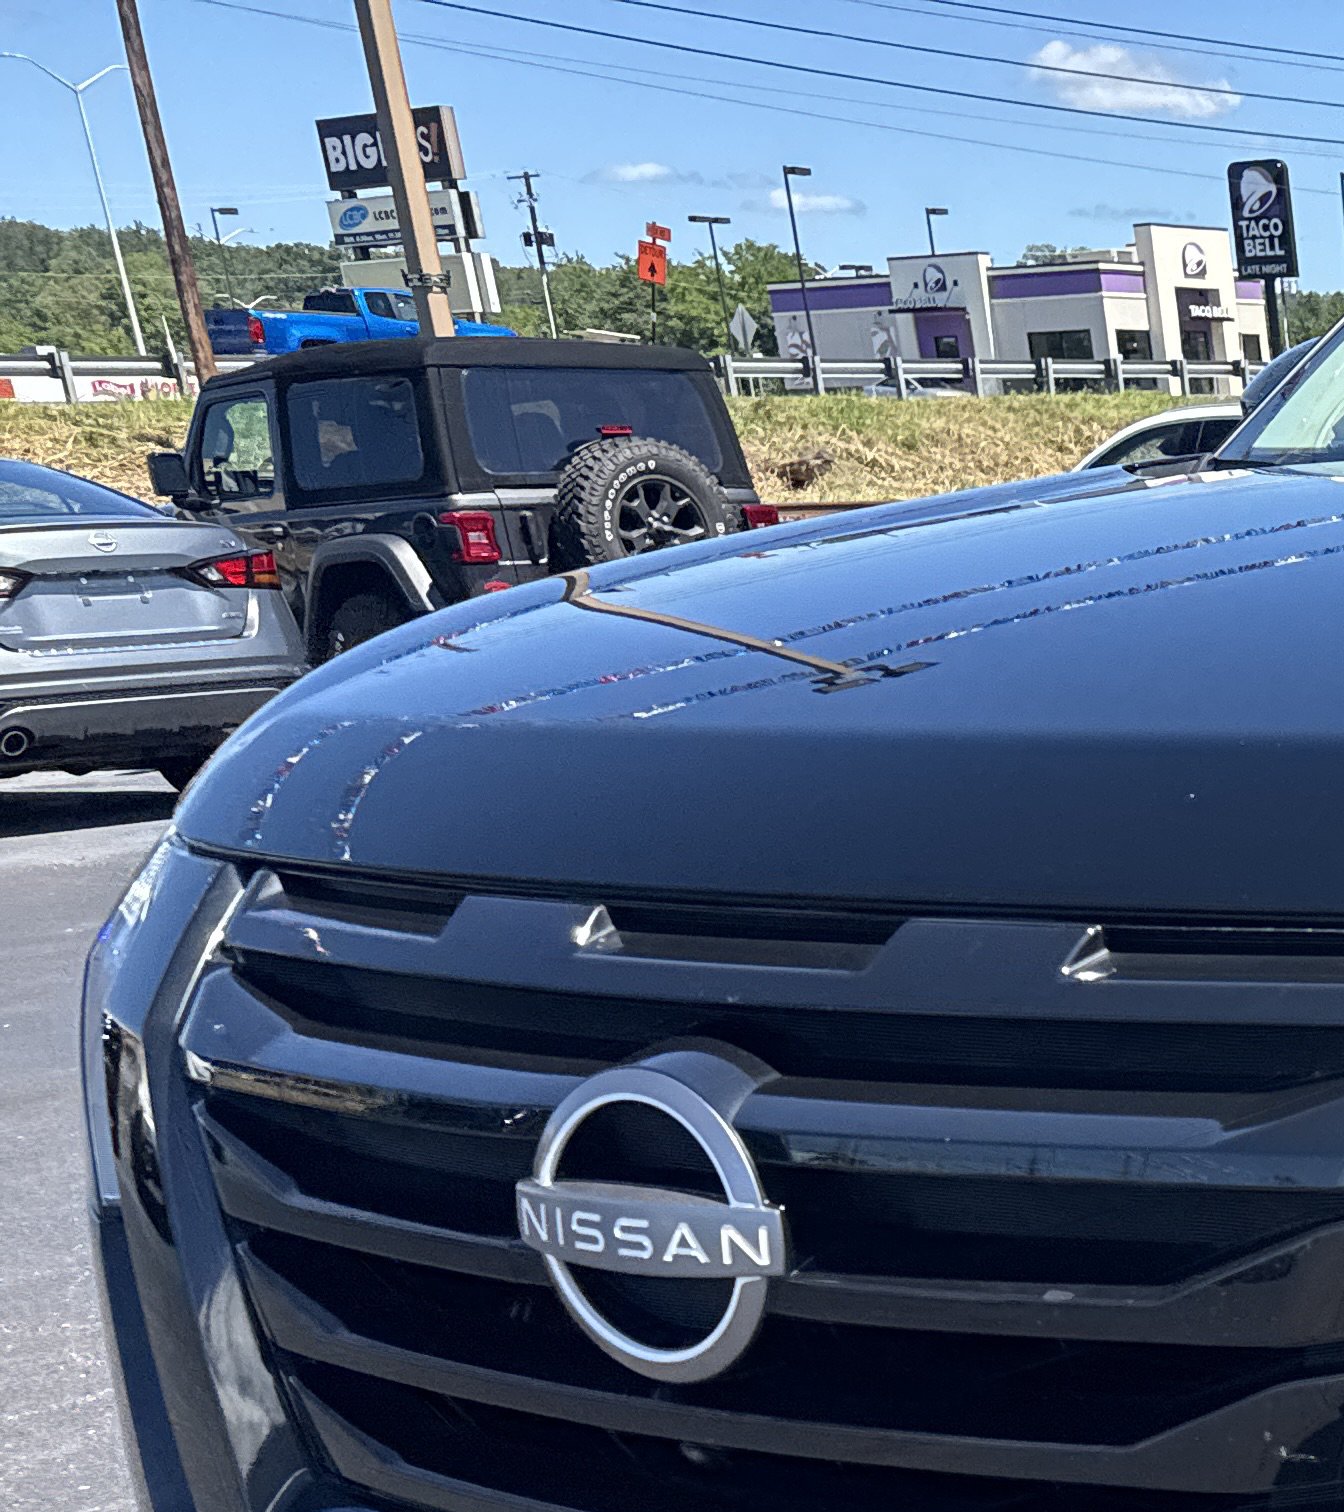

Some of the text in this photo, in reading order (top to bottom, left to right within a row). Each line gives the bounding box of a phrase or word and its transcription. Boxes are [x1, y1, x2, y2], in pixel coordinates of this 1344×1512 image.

[1237, 217, 1284, 239] TACO
[639, 244, 665, 259] DETOUR
[1243, 237, 1286, 258] BELL
[1241, 262, 1288, 276] LATE NIGHT
[1188, 304, 1212, 318] TACO
[518, 1196, 773, 1268] NISSAN
